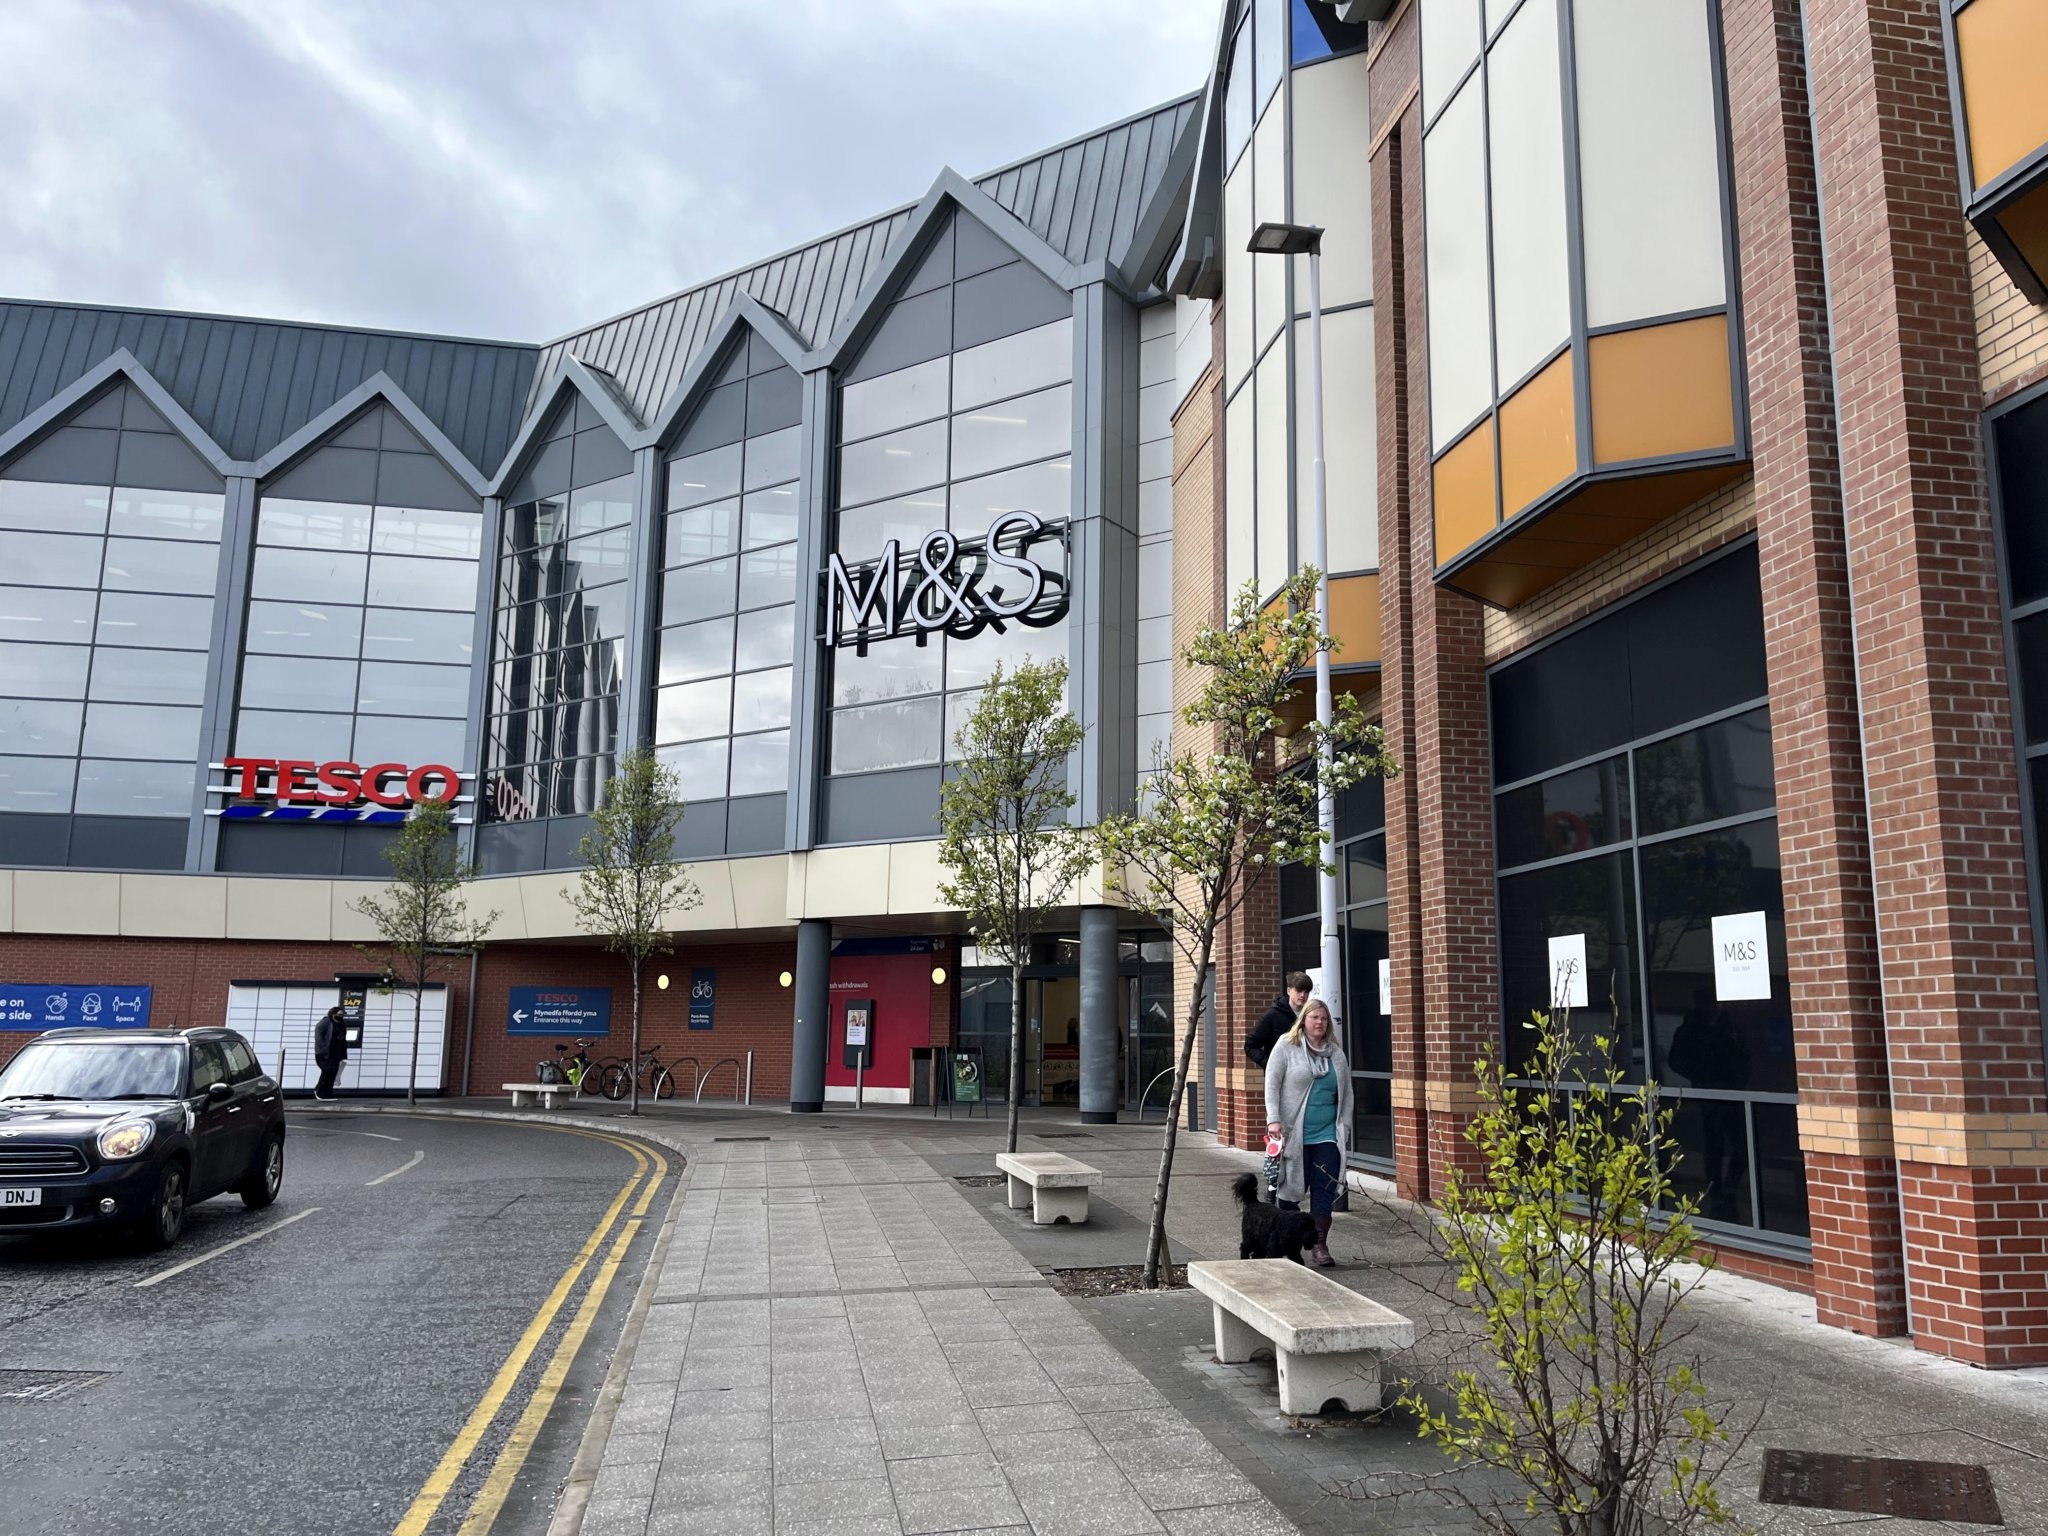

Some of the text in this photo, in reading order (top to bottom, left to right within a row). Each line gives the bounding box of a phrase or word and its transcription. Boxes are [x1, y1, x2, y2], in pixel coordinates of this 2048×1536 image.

[826, 510, 1045, 646] M&S
[224, 757, 461, 805] TESCO
[1724, 941, 1757, 962] M&S
[1556, 957, 1579, 974] M&S
[9, 999, 25, 1007] on
[536, 993, 578, 1002] TESCO
[8, 1010, 32, 1020] side
[534, 1009, 562, 1018] Mynedfa
[562, 1009, 582, 1017] ffordd
[5, 1190, 35, 1204] DNJ
